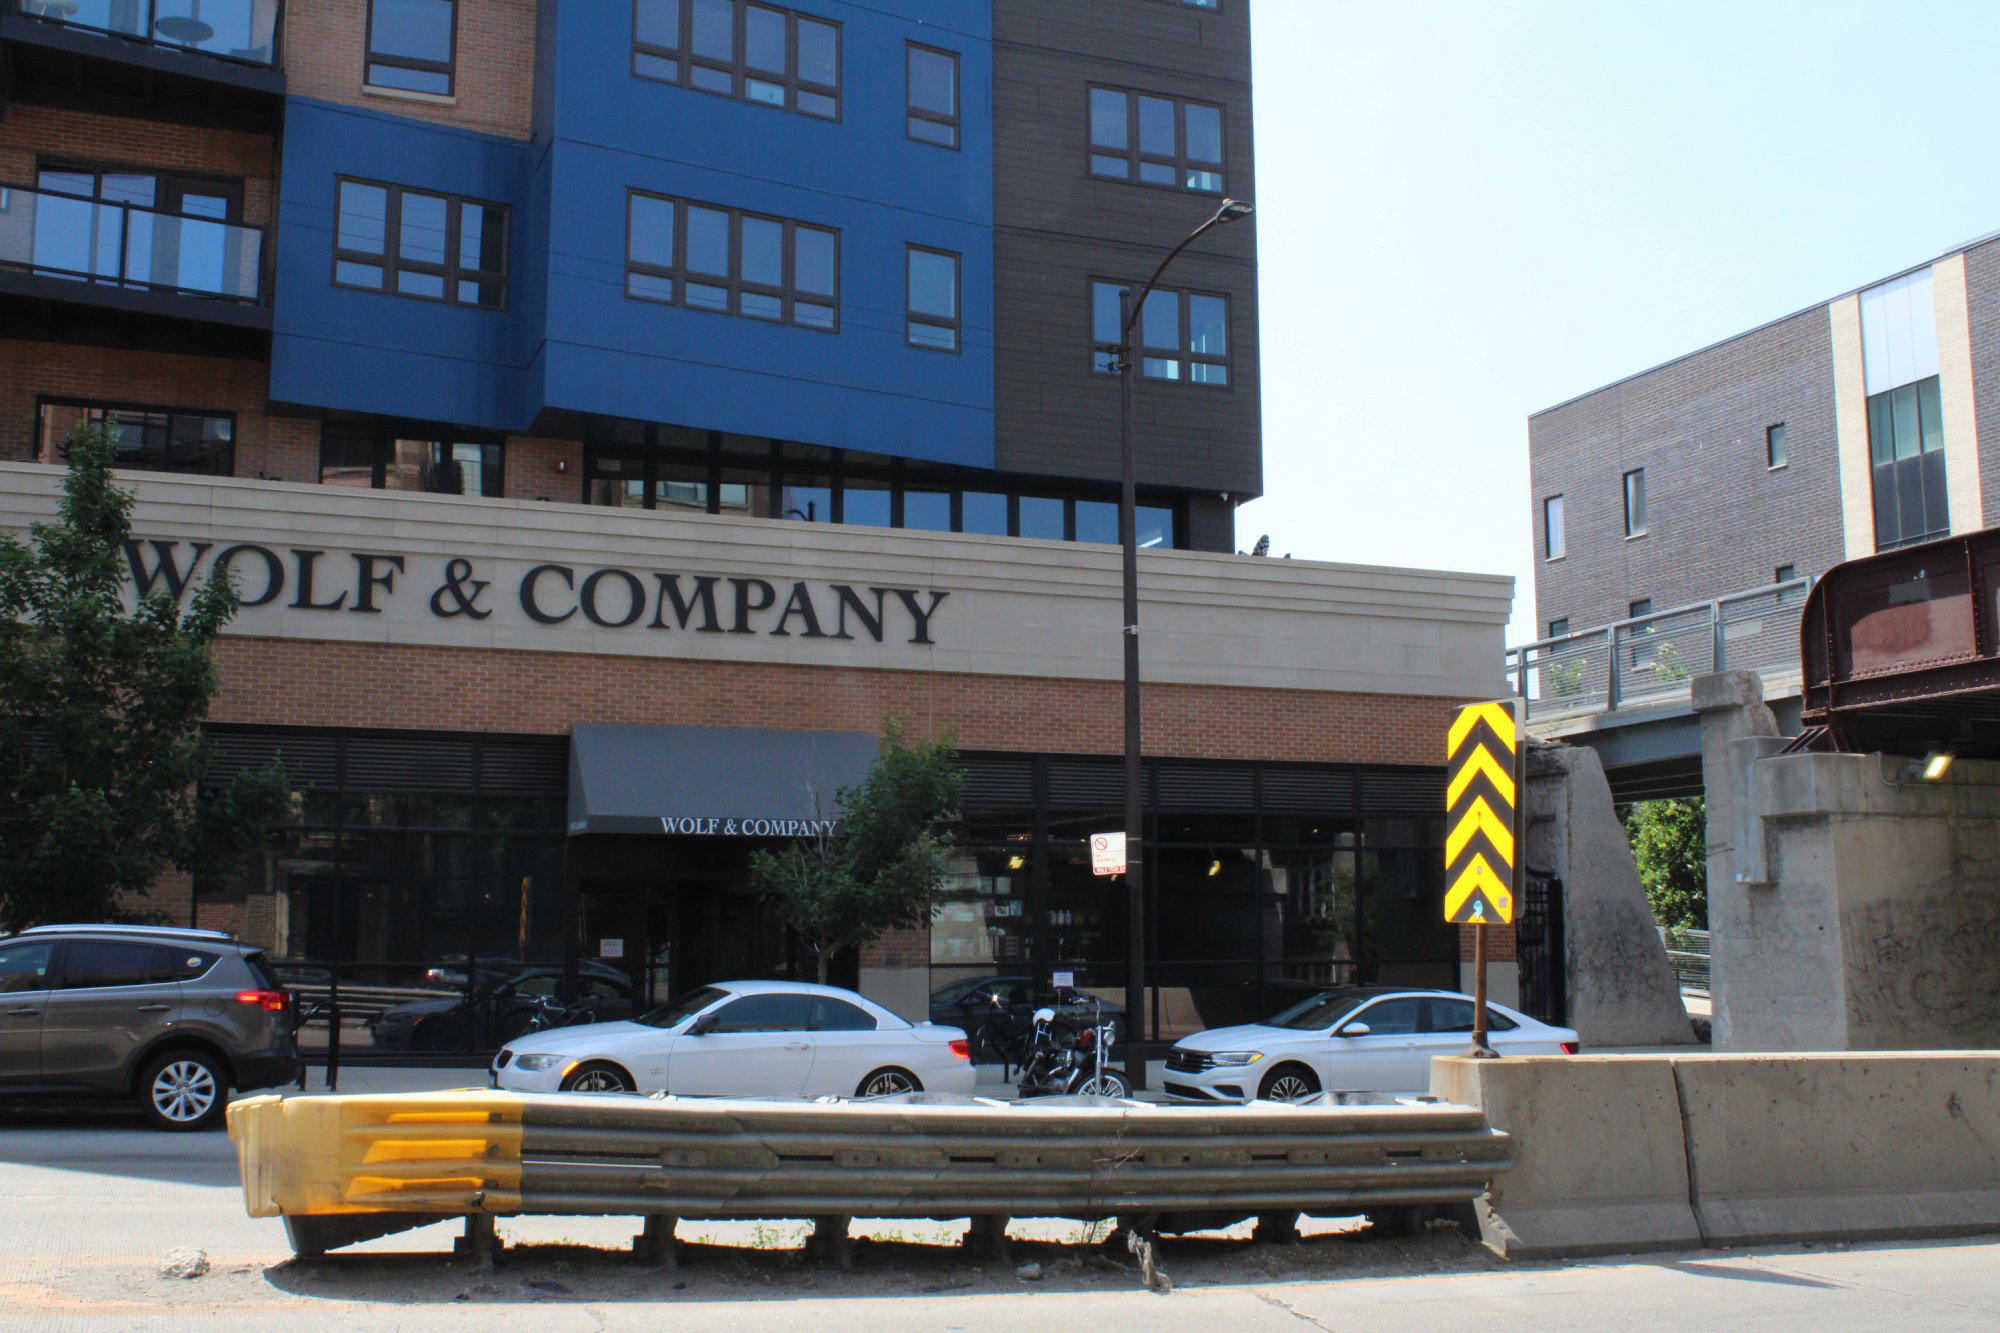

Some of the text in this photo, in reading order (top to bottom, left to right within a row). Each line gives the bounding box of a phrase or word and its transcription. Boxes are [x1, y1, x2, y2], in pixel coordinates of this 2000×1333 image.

[122, 539, 951, 645] WOLF & COMPANY
[660, 816, 837, 837] WOLF & COMPANY
